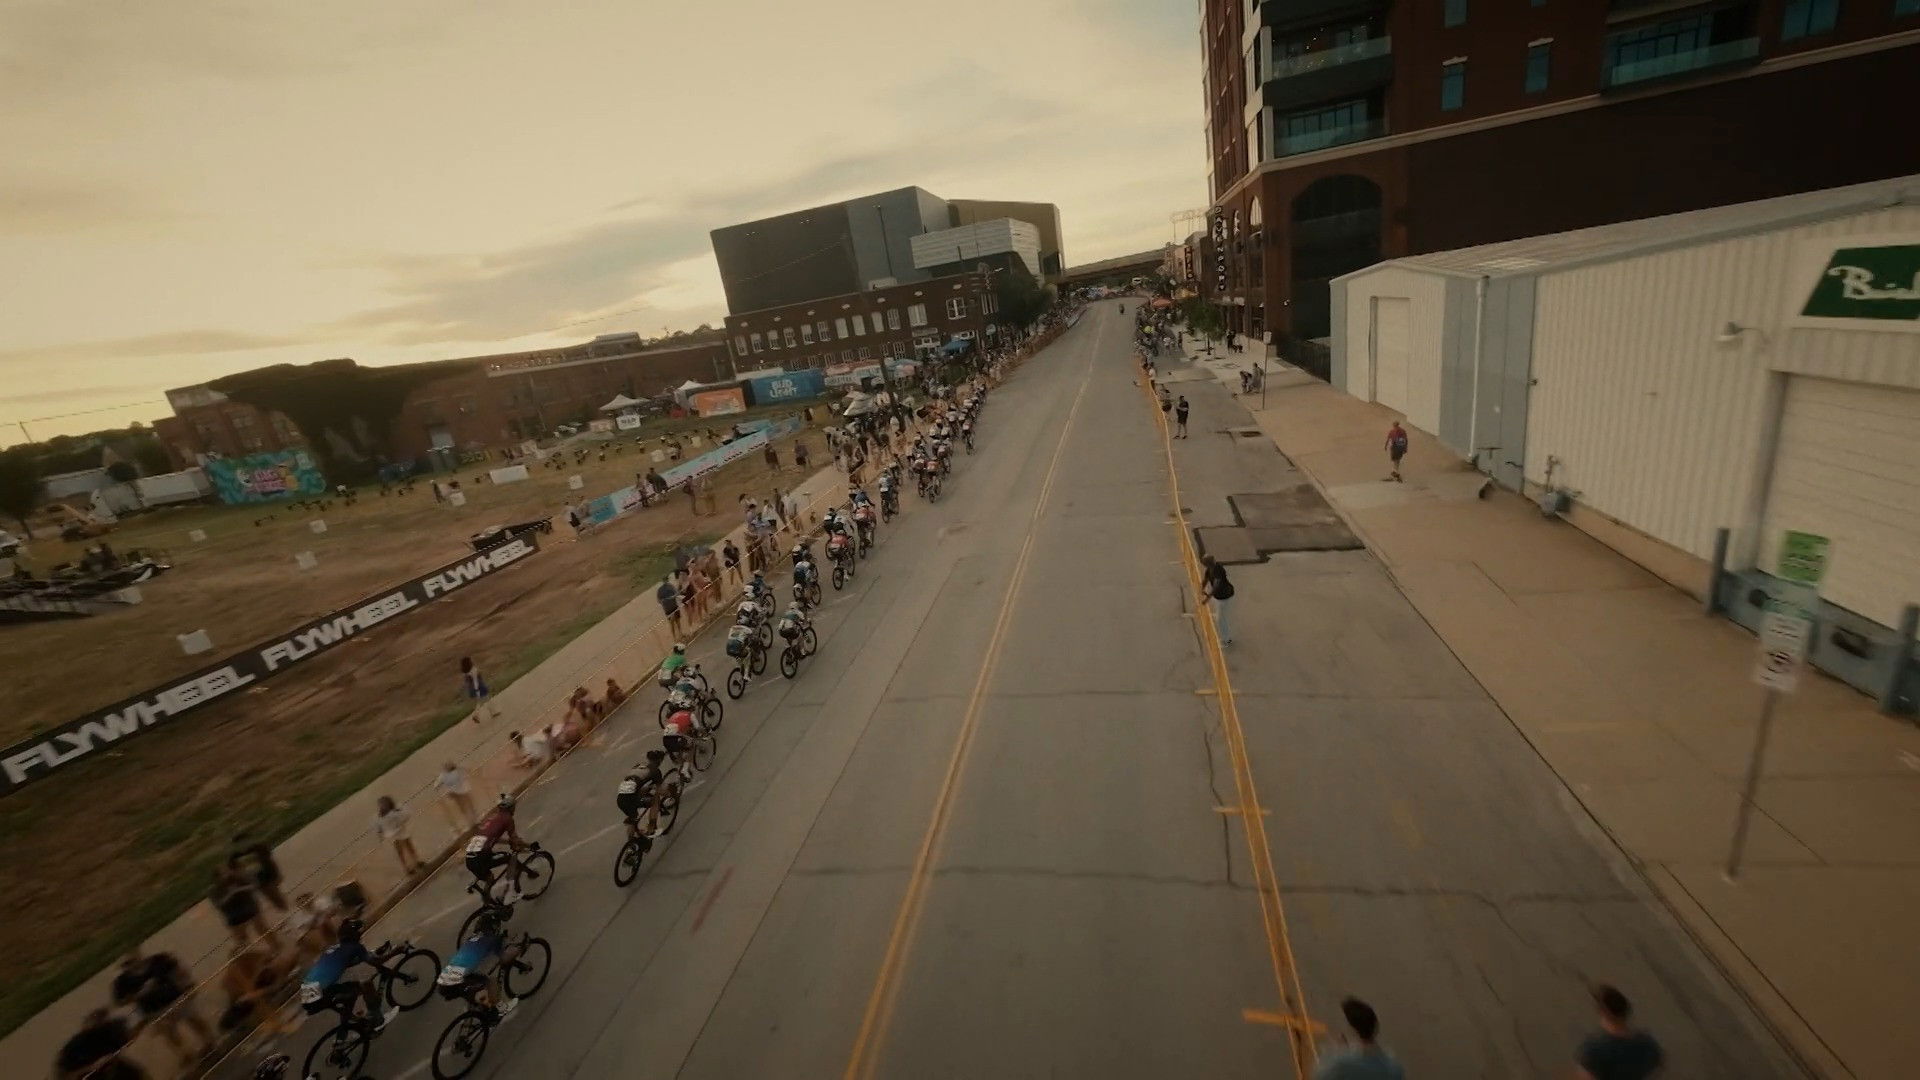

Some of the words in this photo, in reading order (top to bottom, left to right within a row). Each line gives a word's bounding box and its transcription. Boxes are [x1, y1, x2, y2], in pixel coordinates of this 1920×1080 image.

[421, 539, 535, 598] FLYWHEEL
[260, 591, 419, 672] FLYWHEEL
[2, 664, 256, 785] FLYWHEEL
